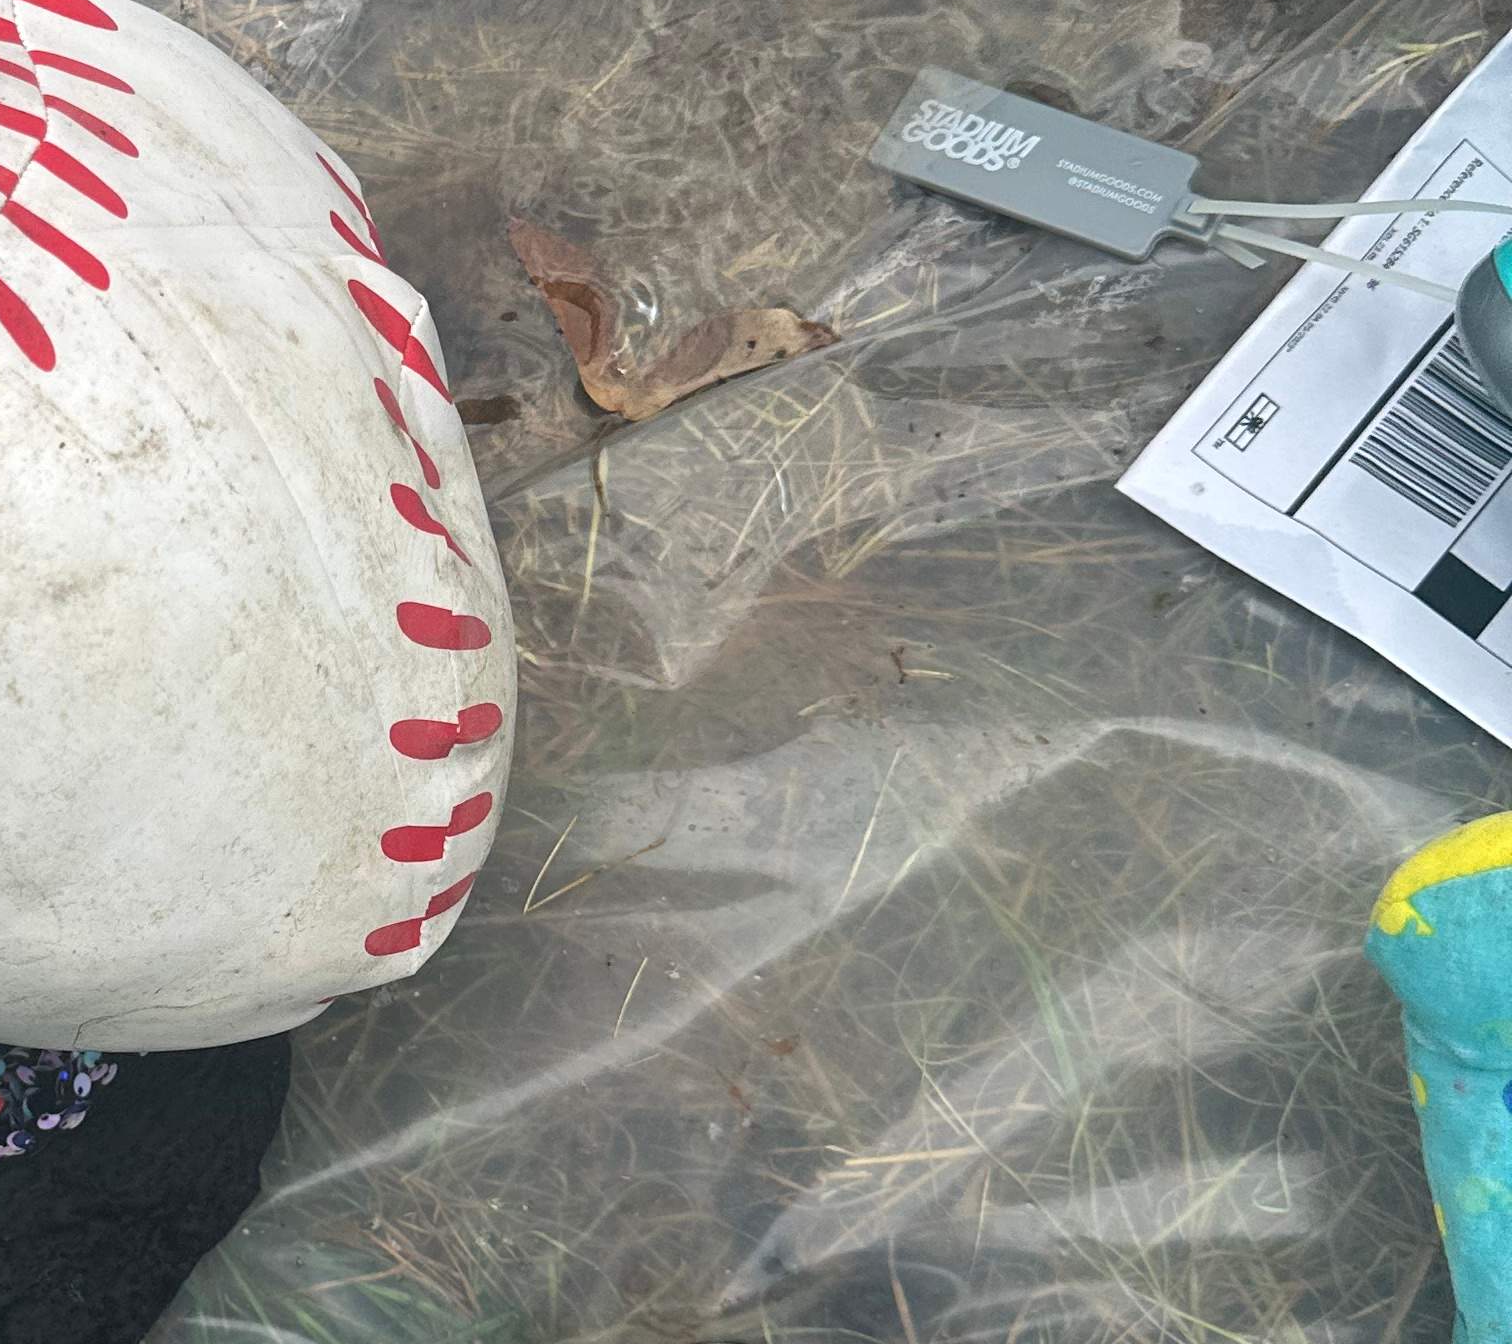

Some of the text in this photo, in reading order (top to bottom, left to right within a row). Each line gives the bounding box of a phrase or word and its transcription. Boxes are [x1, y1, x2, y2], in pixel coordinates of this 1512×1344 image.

[912, 99, 1042, 158] STADIUM
[1056, 158, 1163, 203] STADIUMGOODS.COM
[1437, 157, 1484, 202] Referenc
